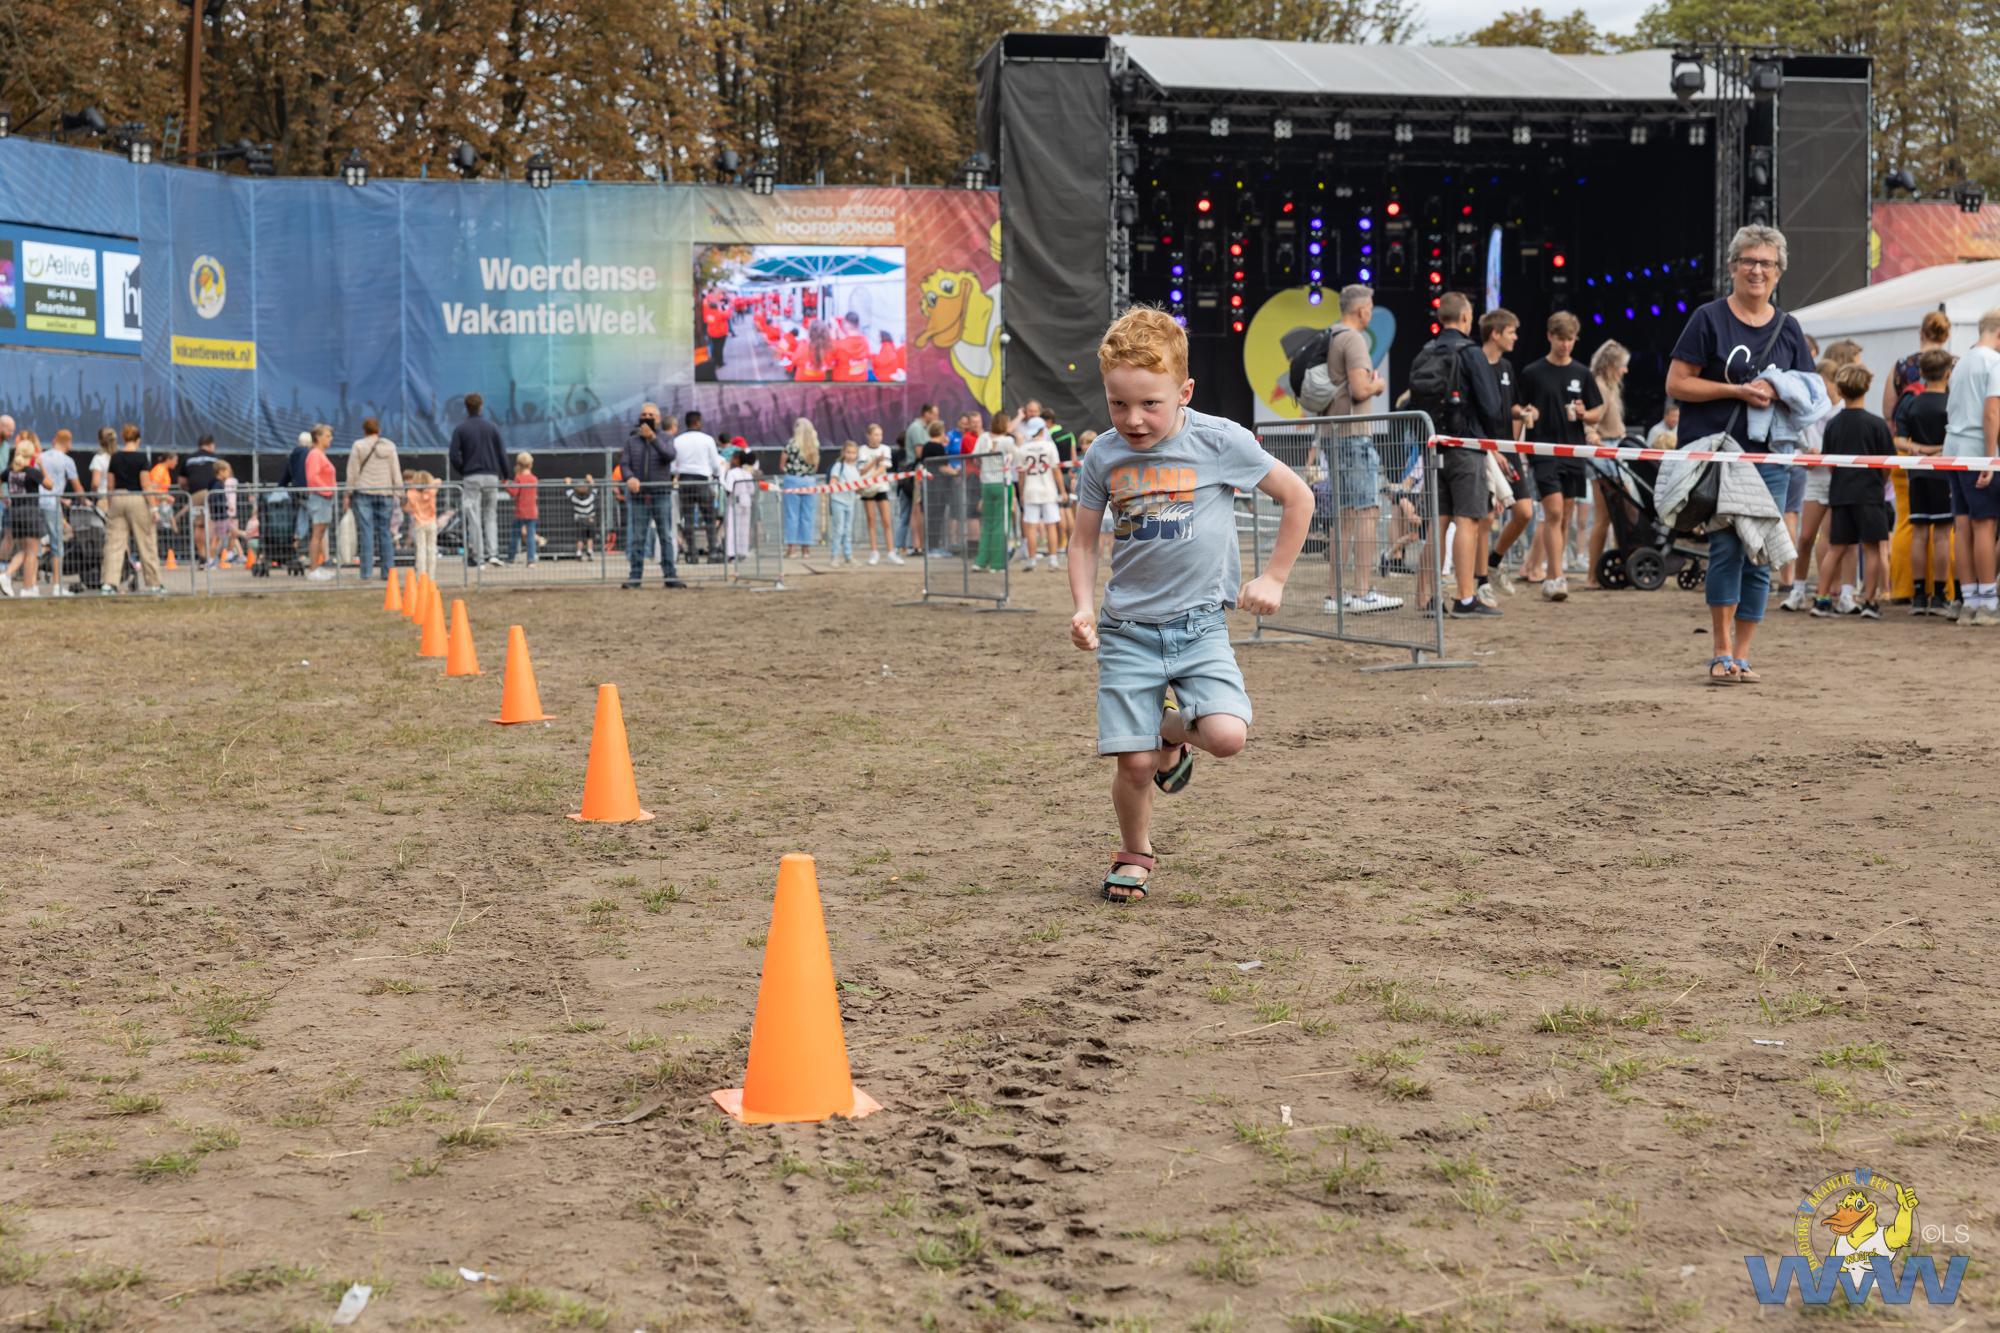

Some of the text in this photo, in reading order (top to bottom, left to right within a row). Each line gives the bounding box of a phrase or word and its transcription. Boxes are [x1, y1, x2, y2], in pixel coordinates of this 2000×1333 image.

[774, 220, 896, 235] HOOFDSPONSOR
[45, 253, 91, 278] Aelivé
[479, 256, 657, 291] Woerdense
[441, 302, 657, 335] VakantieWeek
[175, 343, 251, 361] vakantieweek.nl
[1025, 453, 1048, 476] 25
